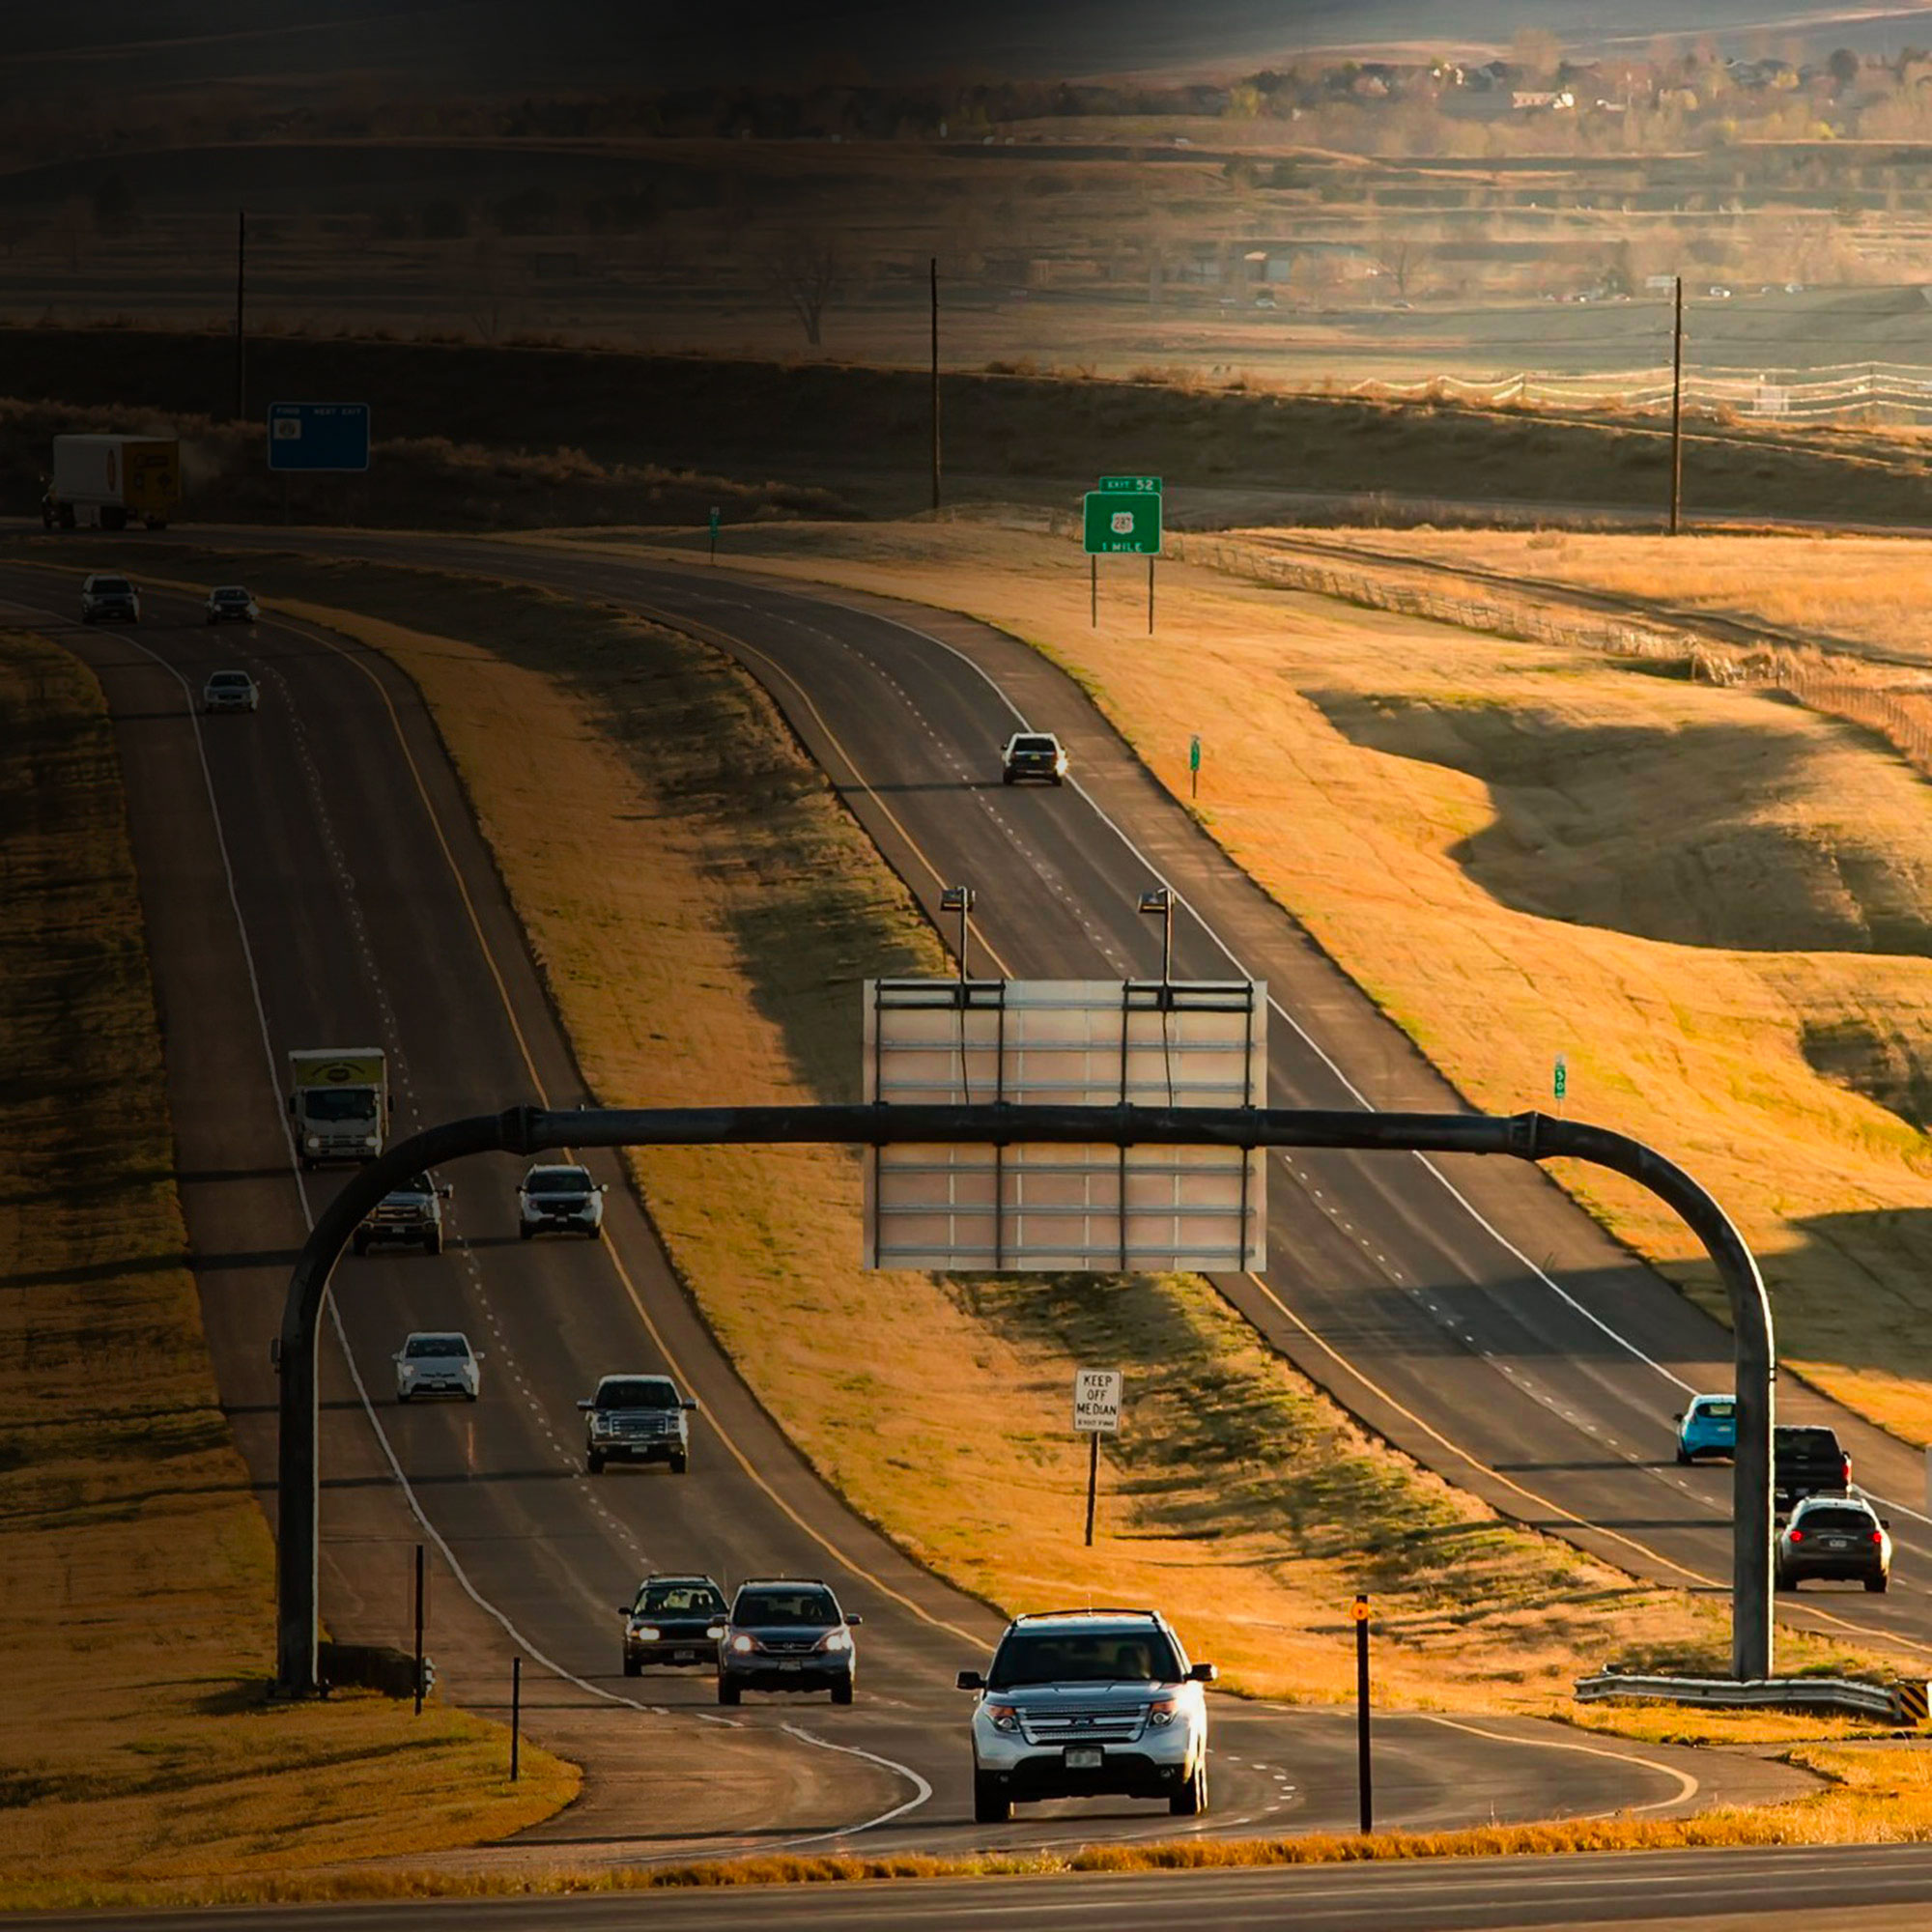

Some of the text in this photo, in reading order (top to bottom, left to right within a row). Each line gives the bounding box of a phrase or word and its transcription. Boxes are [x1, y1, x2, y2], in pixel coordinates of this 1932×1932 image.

[1136, 479, 1152, 491] 52
[1102, 542, 1142, 553] 1 MILE
[1084, 1375, 1112, 1386] KEEP
[1087, 1389, 1107, 1401] OFF
[1077, 1403, 1117, 1415] MEDIAN
